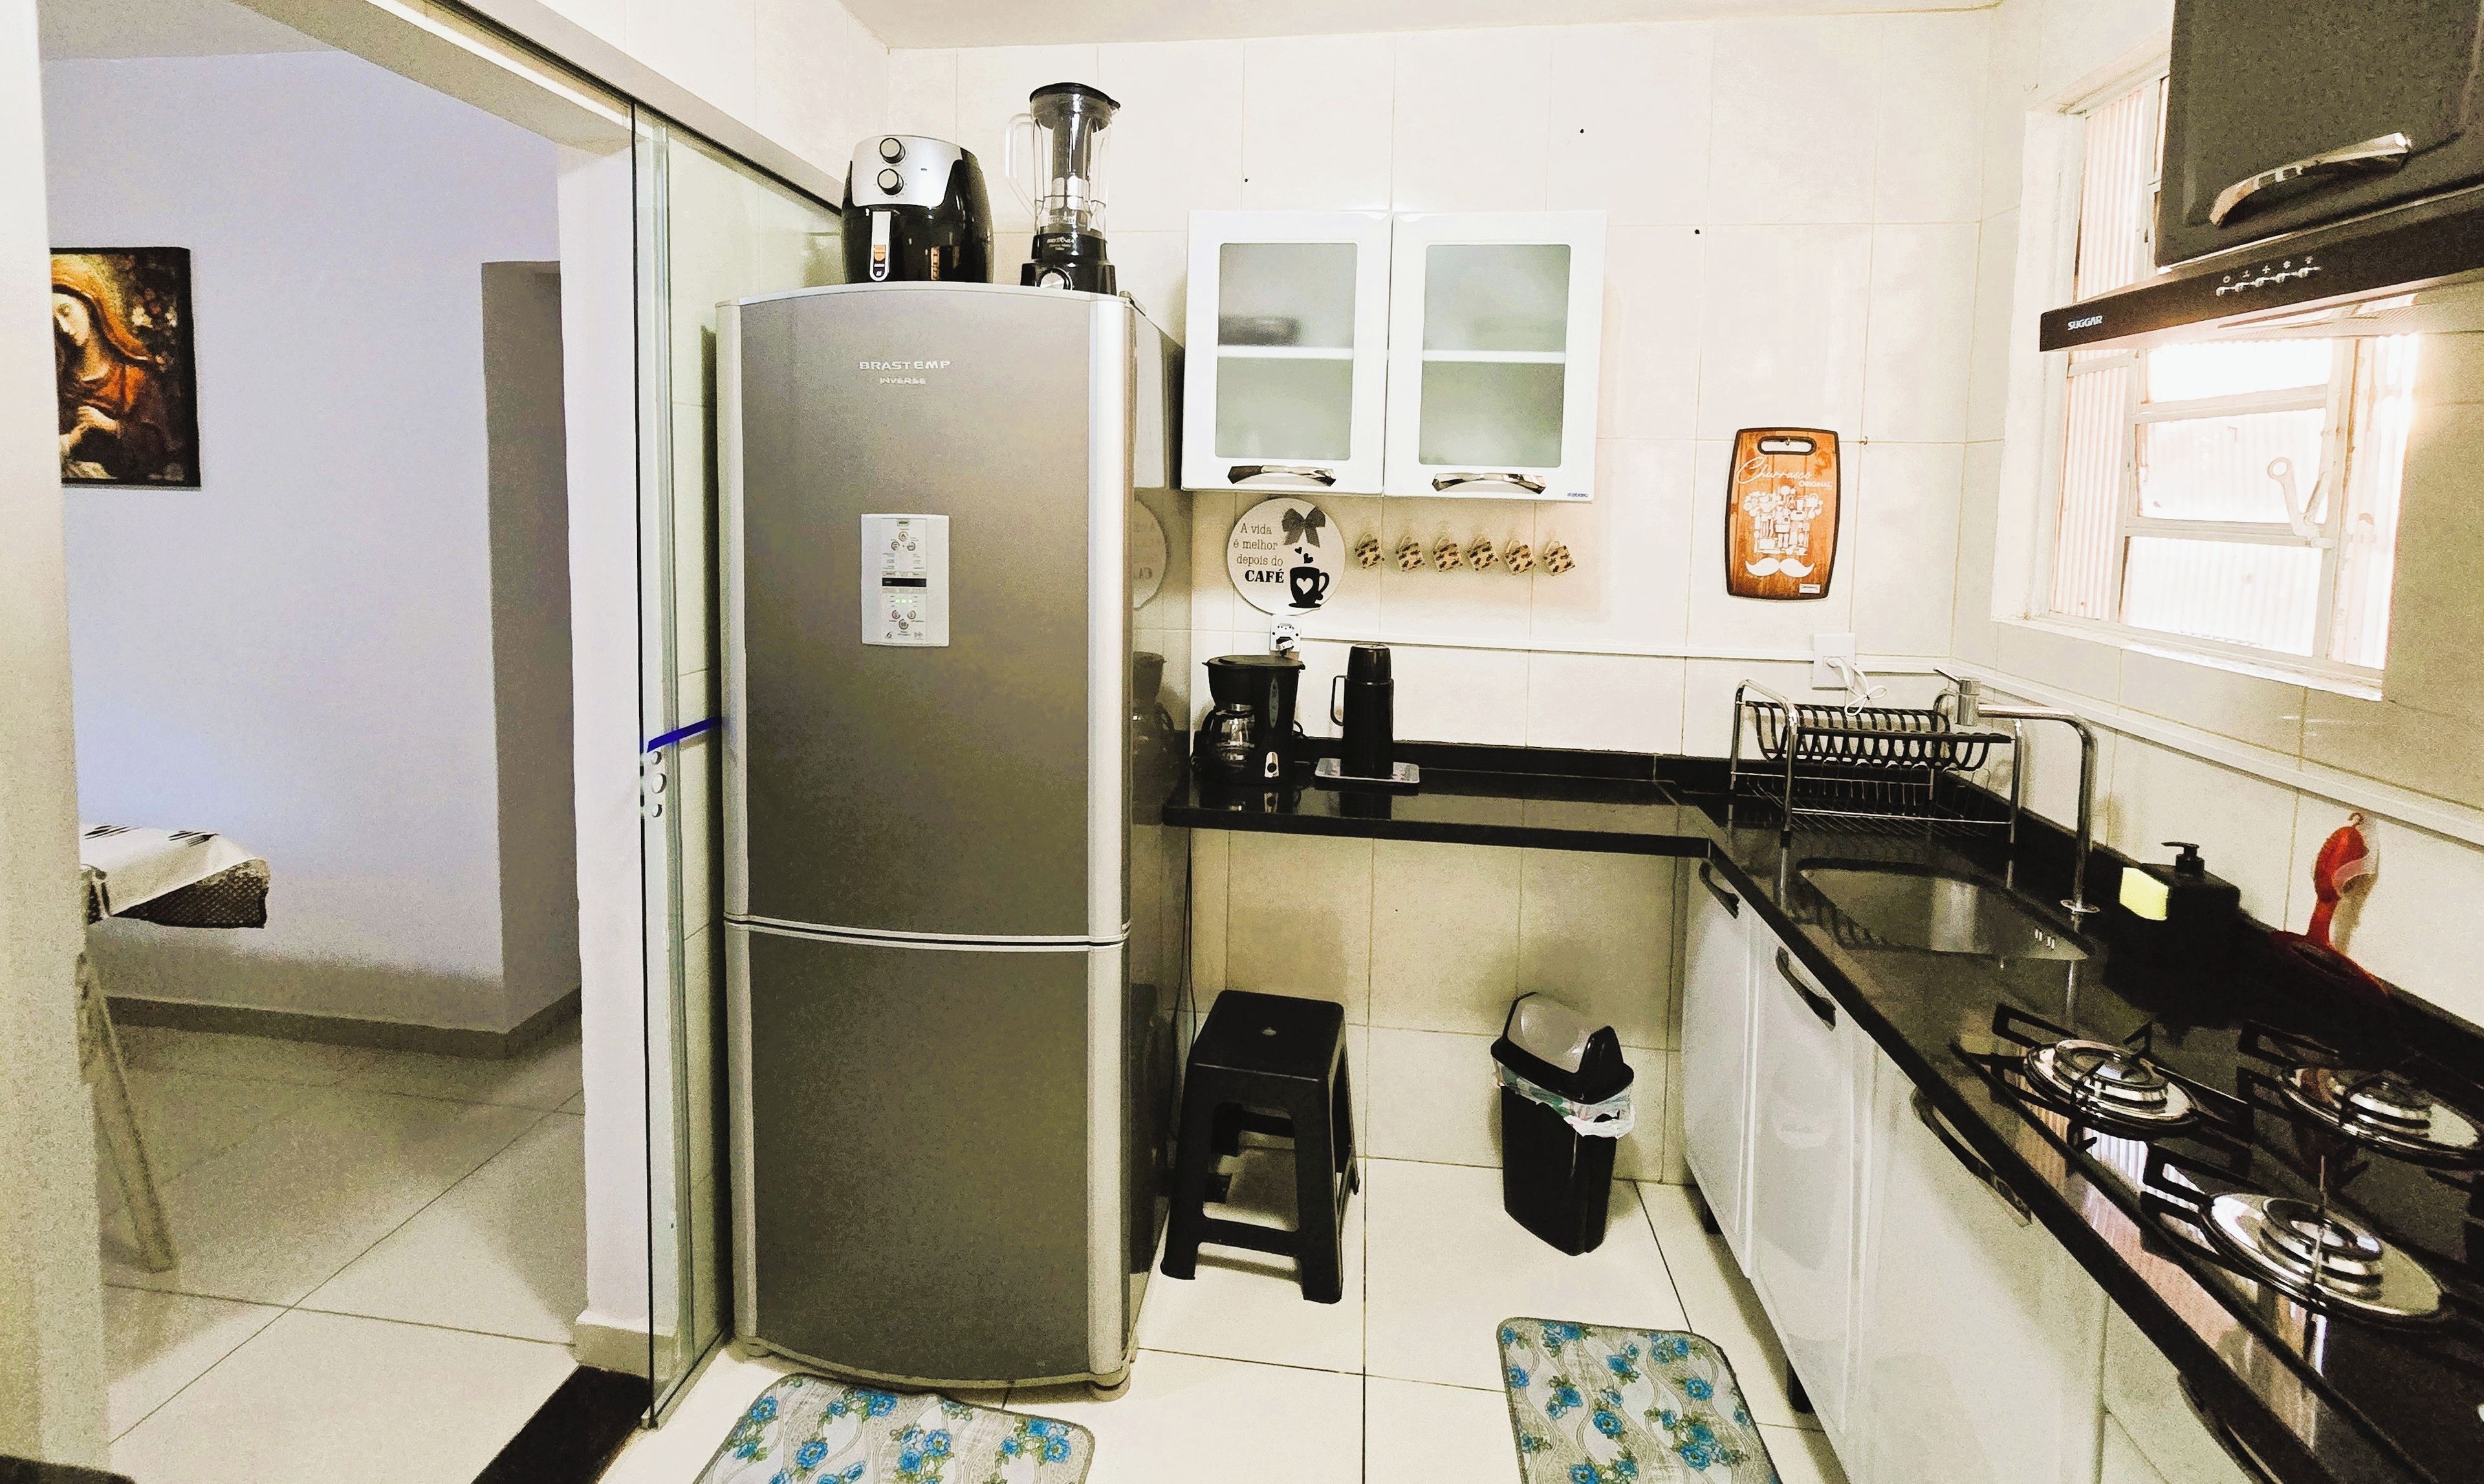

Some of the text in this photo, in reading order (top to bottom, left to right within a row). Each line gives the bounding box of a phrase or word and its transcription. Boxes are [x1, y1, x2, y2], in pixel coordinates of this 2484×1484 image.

[2067, 315, 2102, 330] SUGGAR
[859, 360, 950, 370] BRASTEMP
[1240, 523, 1272, 534] A vida
[1233, 539, 1278, 550] é melhor
[1236, 554, 1283, 566] depois do
[1245, 569, 1284, 583] CAFÉ
